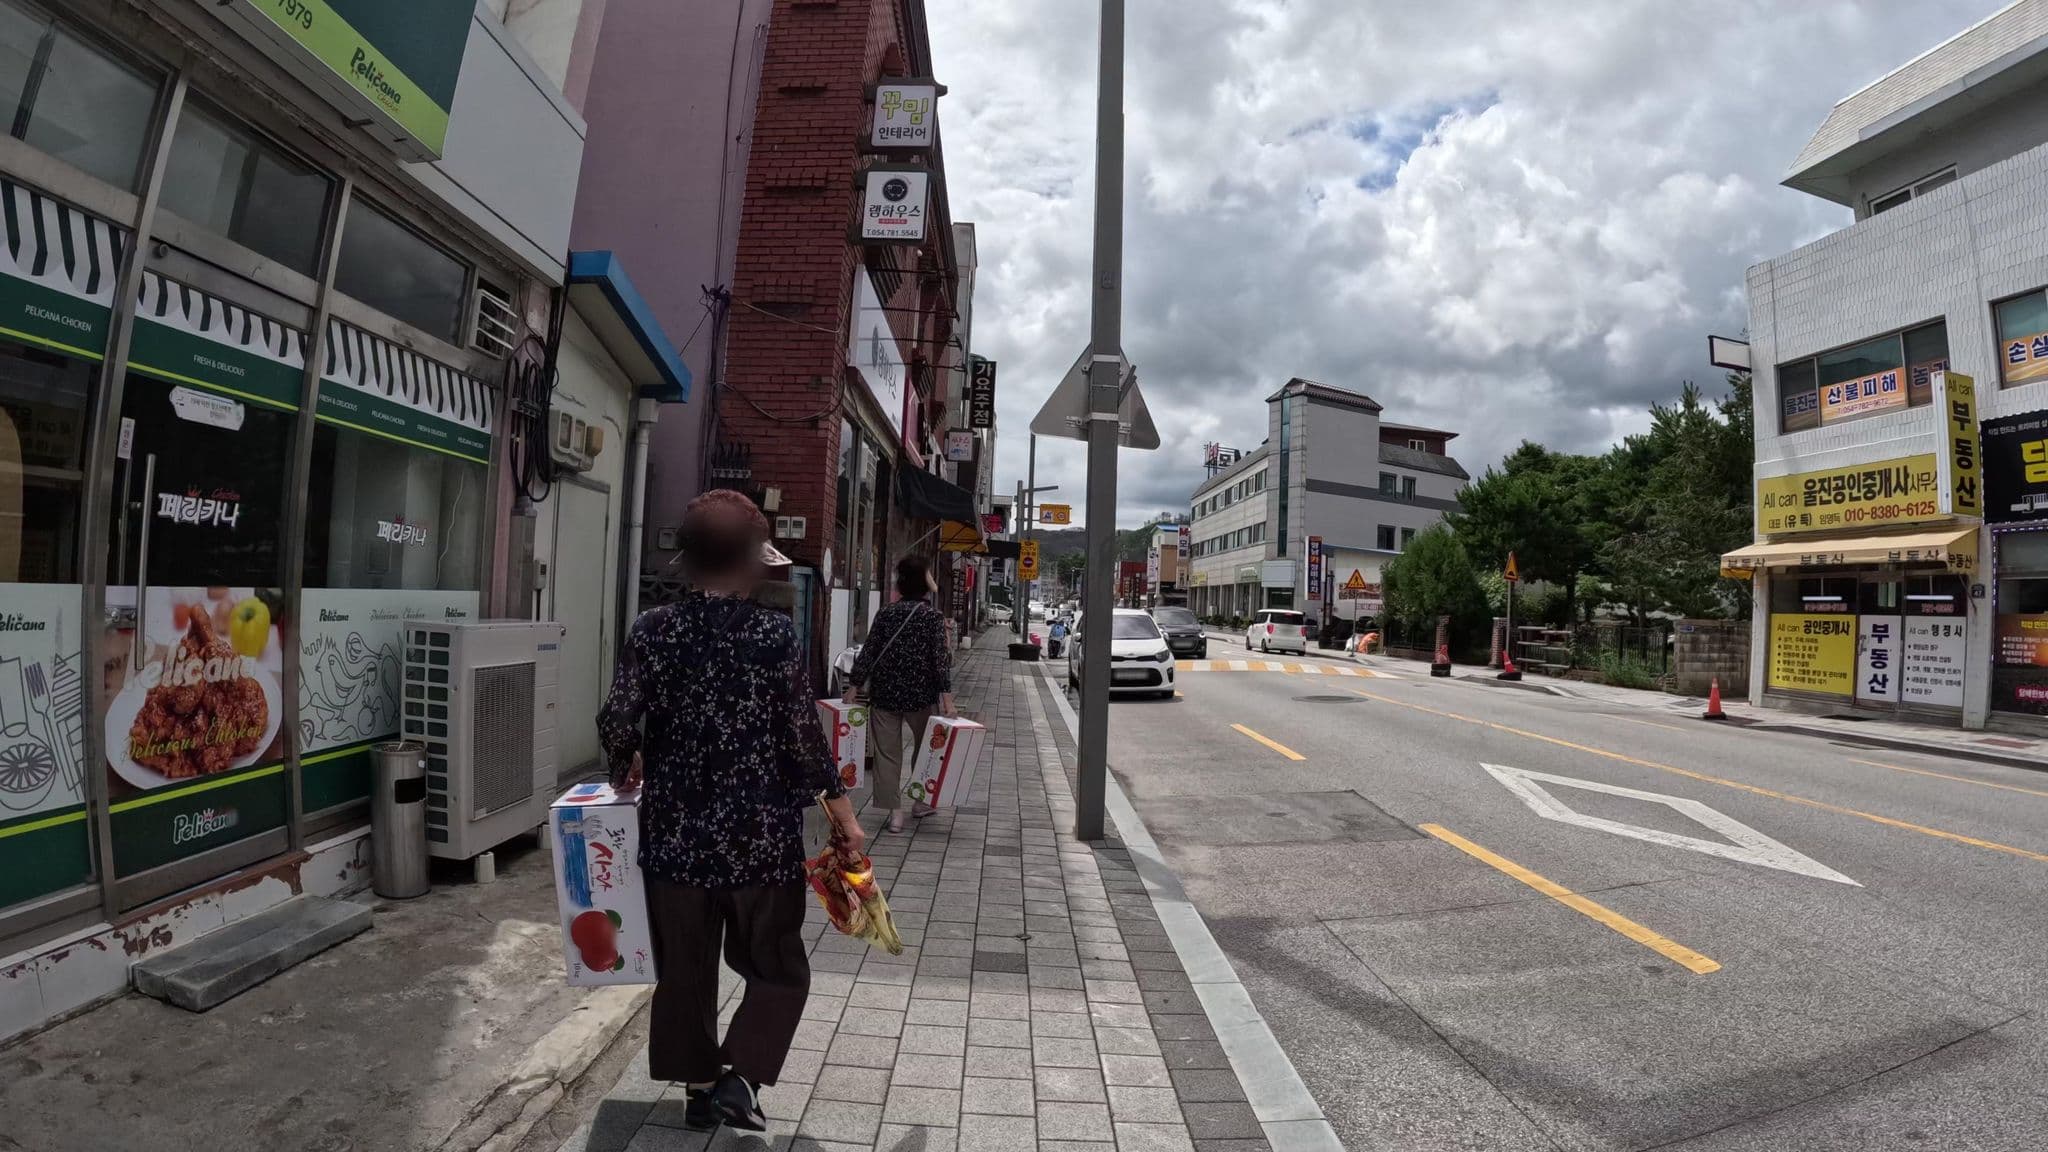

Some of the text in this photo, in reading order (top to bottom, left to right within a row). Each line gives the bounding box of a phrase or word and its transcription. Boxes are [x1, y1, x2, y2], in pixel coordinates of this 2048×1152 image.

[350, 47, 402, 104] Pelicana
[878, 126, 926, 140] 인테리어
[869, 204, 921, 218] 렘하우스
[25, 304, 92, 333] PELICANA CHICKEN
[193, 353, 212, 365] FRESH
[216, 361, 246, 377] DELICIOUS
[973, 363, 993, 425] 가요주점
[1948, 379, 1957, 392] All
[1785, 391, 1817, 416] 울진군
[1952, 400, 1976, 508] 부동산
[158, 493, 240, 526] 페리카나
[1763, 493, 1776, 509] All
[1778, 493, 1798, 508] can
[1844, 501, 1936, 522] 010-8380-6125
[377, 521, 427, 546] 페리카나
[319, 608, 349, 622] Pelicana
[445, 607, 467, 618] Pelicana
[1803, 620, 1850, 636] 공인중개사
[1869, 623, 1889, 694] 부동산
[127, 718, 262, 760] Delicious Chicken
[173, 808, 238, 845] Pelican
[589, 841, 614, 892] 사과
